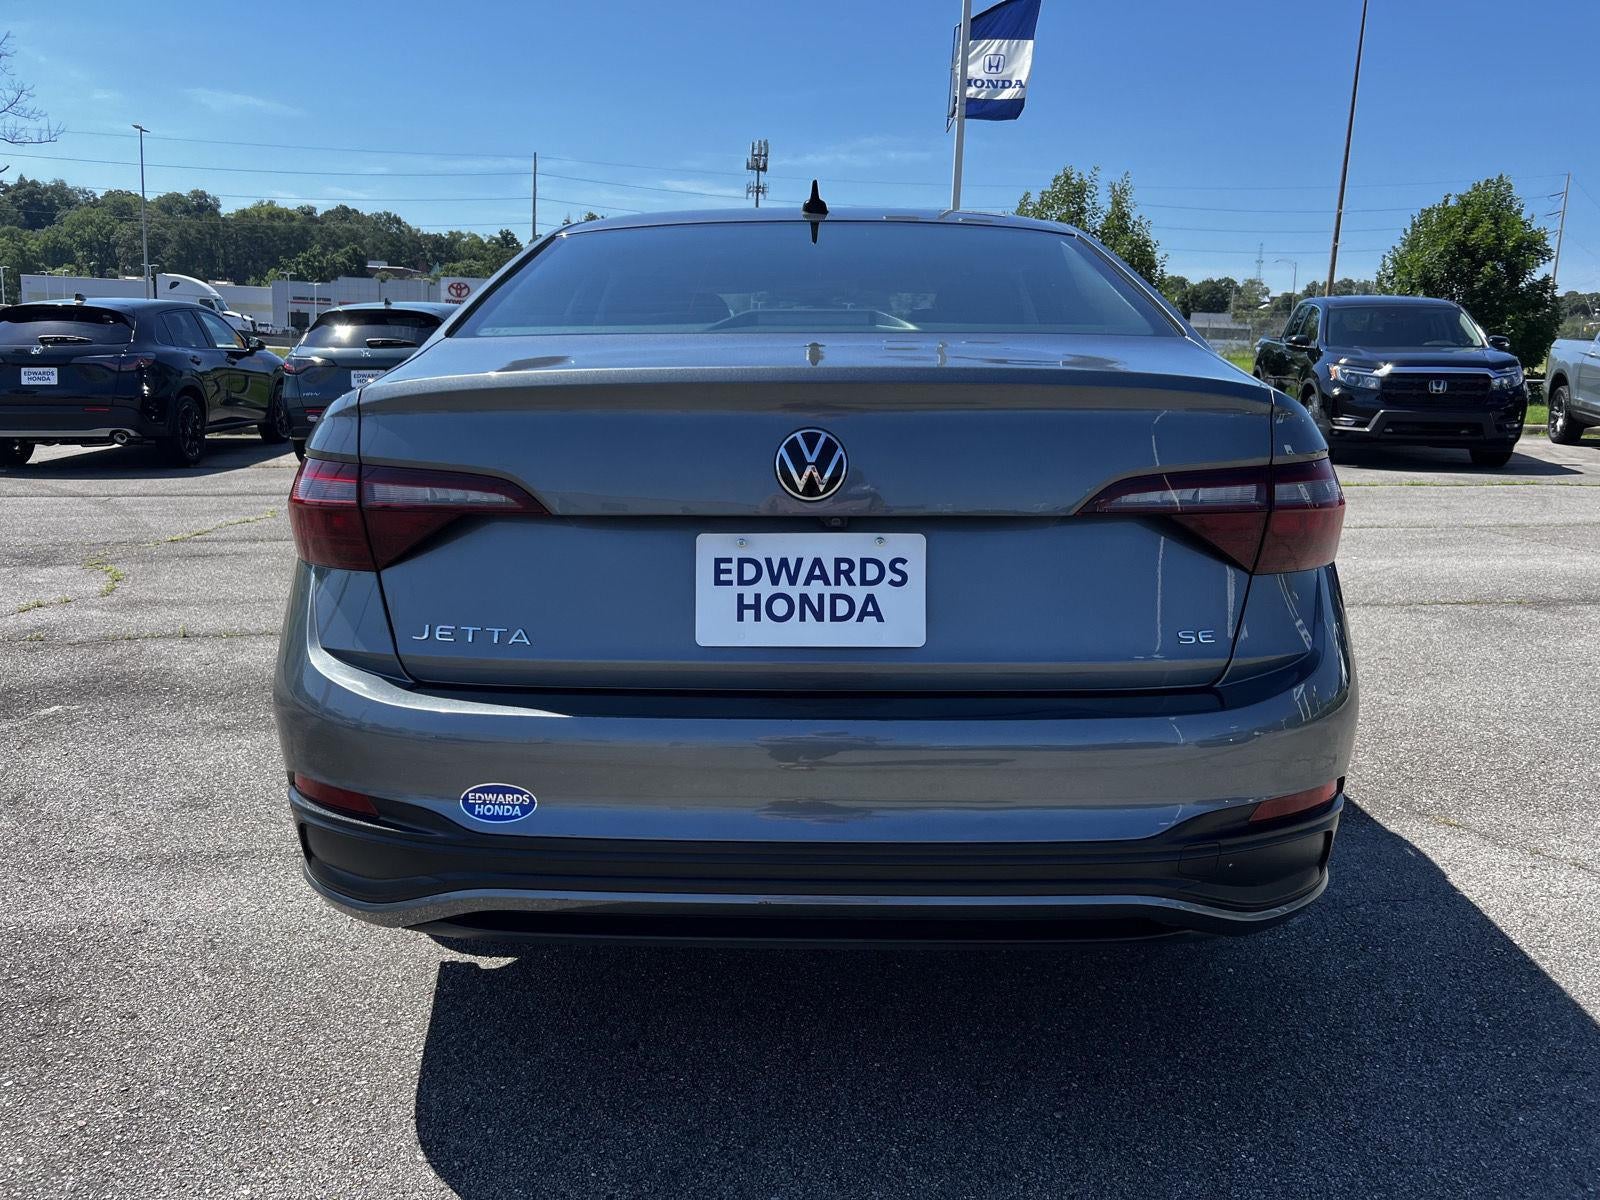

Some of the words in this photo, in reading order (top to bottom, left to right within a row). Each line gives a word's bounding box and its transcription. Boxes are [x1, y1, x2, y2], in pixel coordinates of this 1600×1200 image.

[713, 556, 909, 588] EDWARDS
[736, 592, 885, 623] HONDA
[412, 624, 532, 646] JETTA
[1177, 630, 1216, 644] SE
[468, 792, 530, 805] EDWARDS
[474, 804, 522, 816] HONDA
